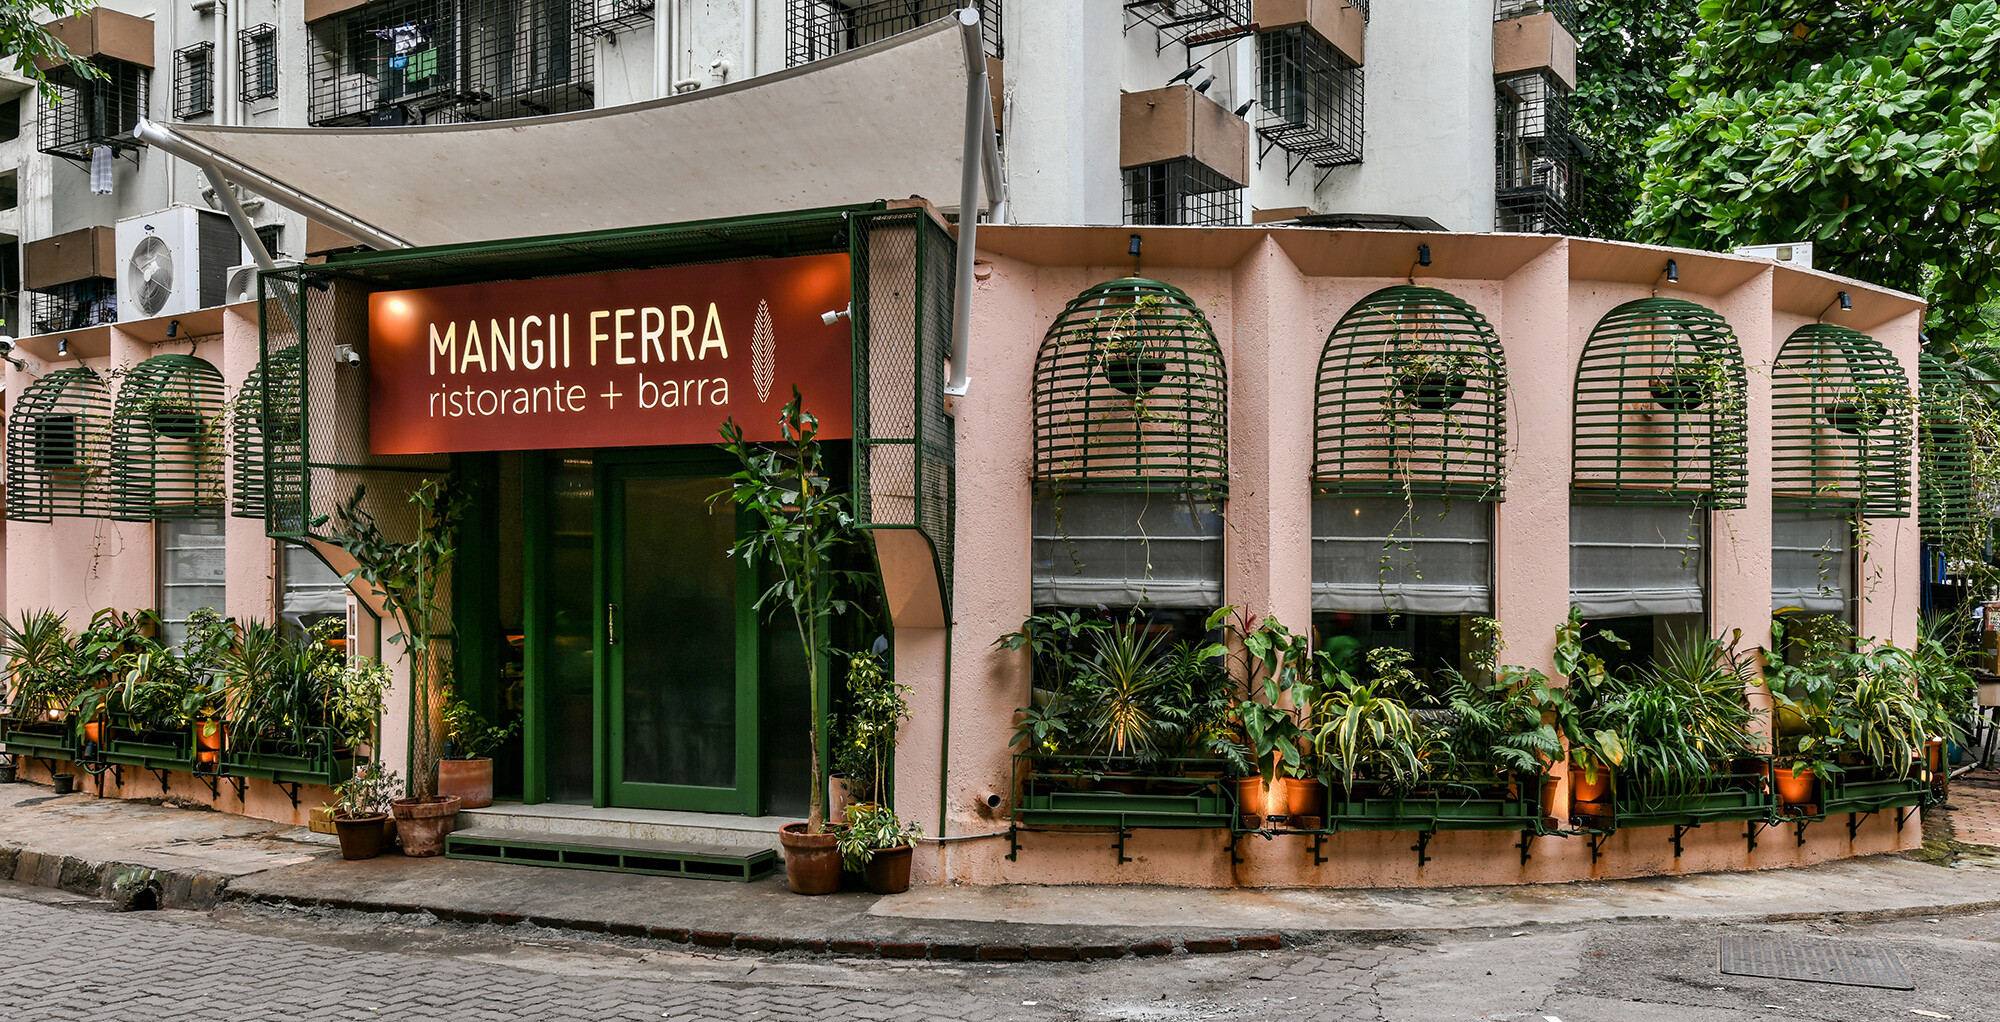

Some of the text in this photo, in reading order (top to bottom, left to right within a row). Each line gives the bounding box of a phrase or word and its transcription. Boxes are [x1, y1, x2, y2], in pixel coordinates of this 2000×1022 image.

[429, 302, 729, 376] MANGII FERRA
[430, 372, 729, 418] ristorante + barra
